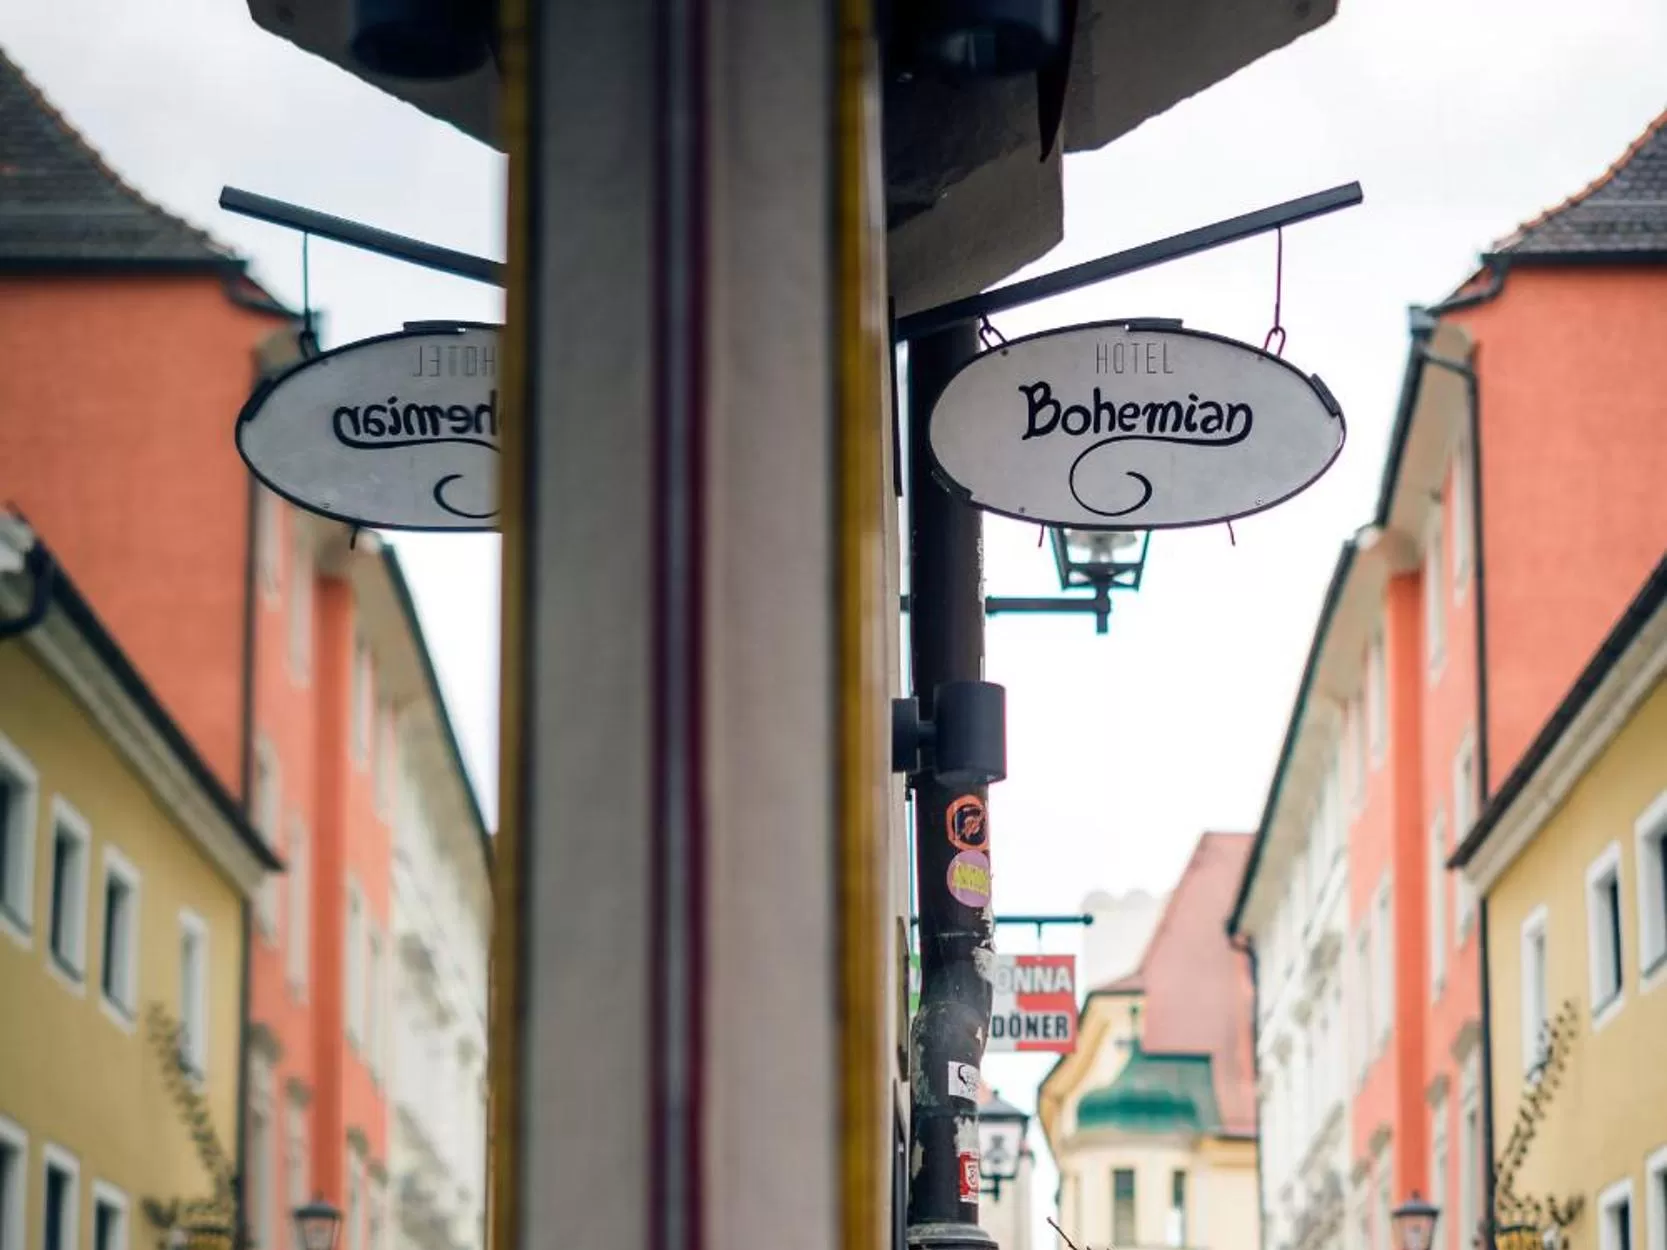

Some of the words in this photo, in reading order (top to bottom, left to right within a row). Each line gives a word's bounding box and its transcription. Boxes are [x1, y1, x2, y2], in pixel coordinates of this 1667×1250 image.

[1096, 342, 1174, 374] HOTEL
[1018, 380, 1254, 446] Bohemian
[993, 965, 1073, 994] ONNA
[992, 1011, 1068, 1039] DÖNER
